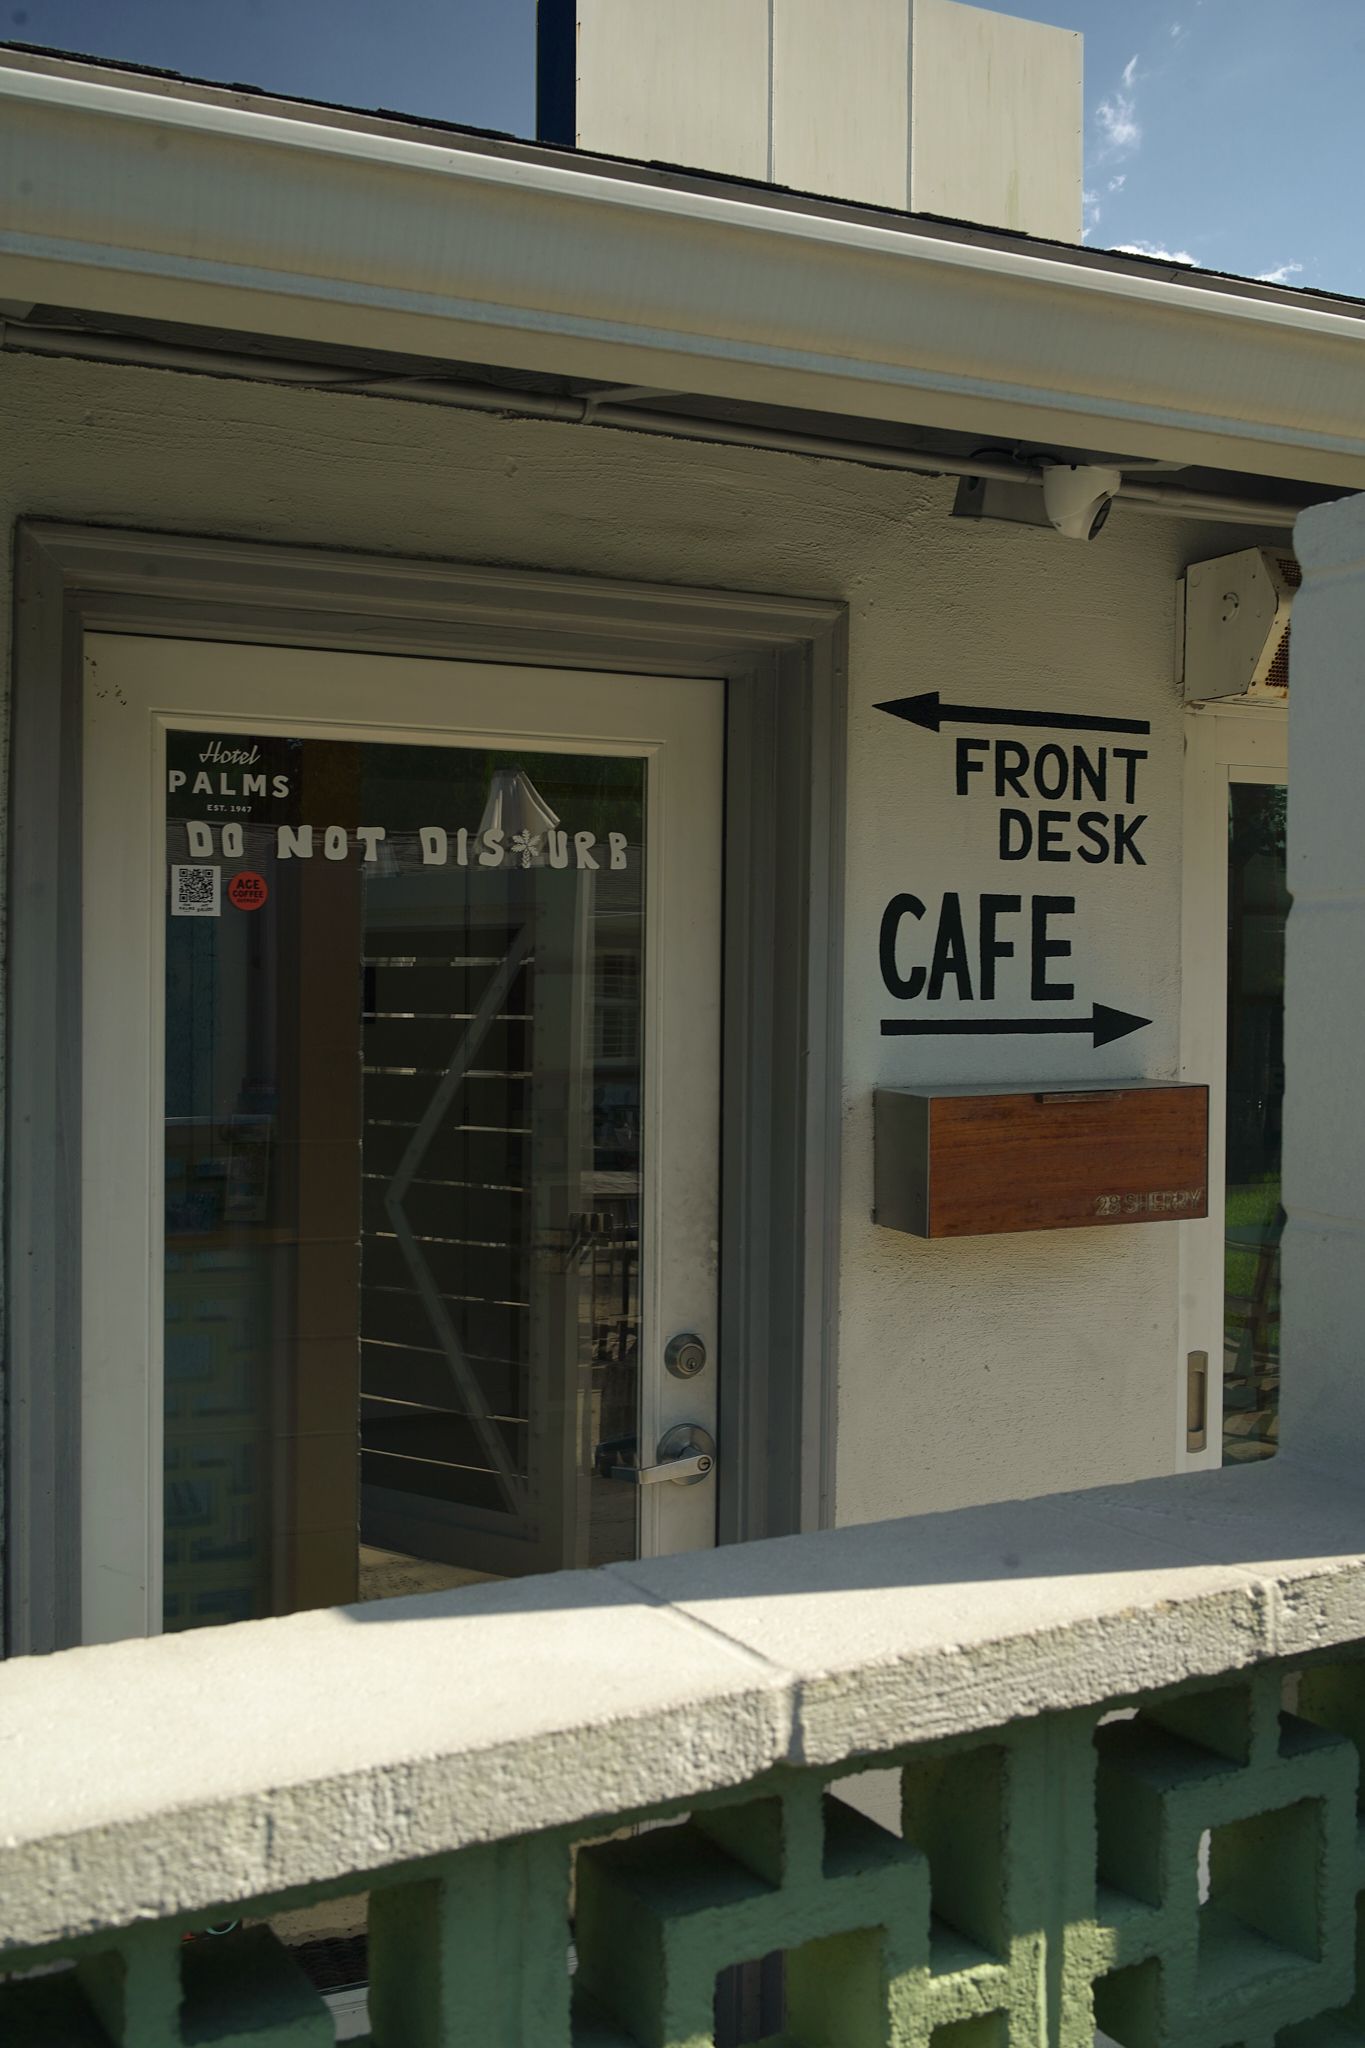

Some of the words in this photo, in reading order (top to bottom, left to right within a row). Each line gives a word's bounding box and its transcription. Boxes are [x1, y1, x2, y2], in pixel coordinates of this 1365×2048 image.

[199, 741, 261, 765] Hotel
[168, 770, 290, 798] PALMS
[956, 738, 1149, 804] FRONT
[207, 804, 228, 812] EST.
[186, 820, 245, 858] DO
[276, 824, 386, 862] NOT
[1000, 808, 1149, 865] DESK
[236, 879, 261, 890] ACE
[879, 892, 1076, 1001] CAFE
[1095, 1194, 1121, 1216] 28
[1123, 1188, 1202, 1214] SHERRY
